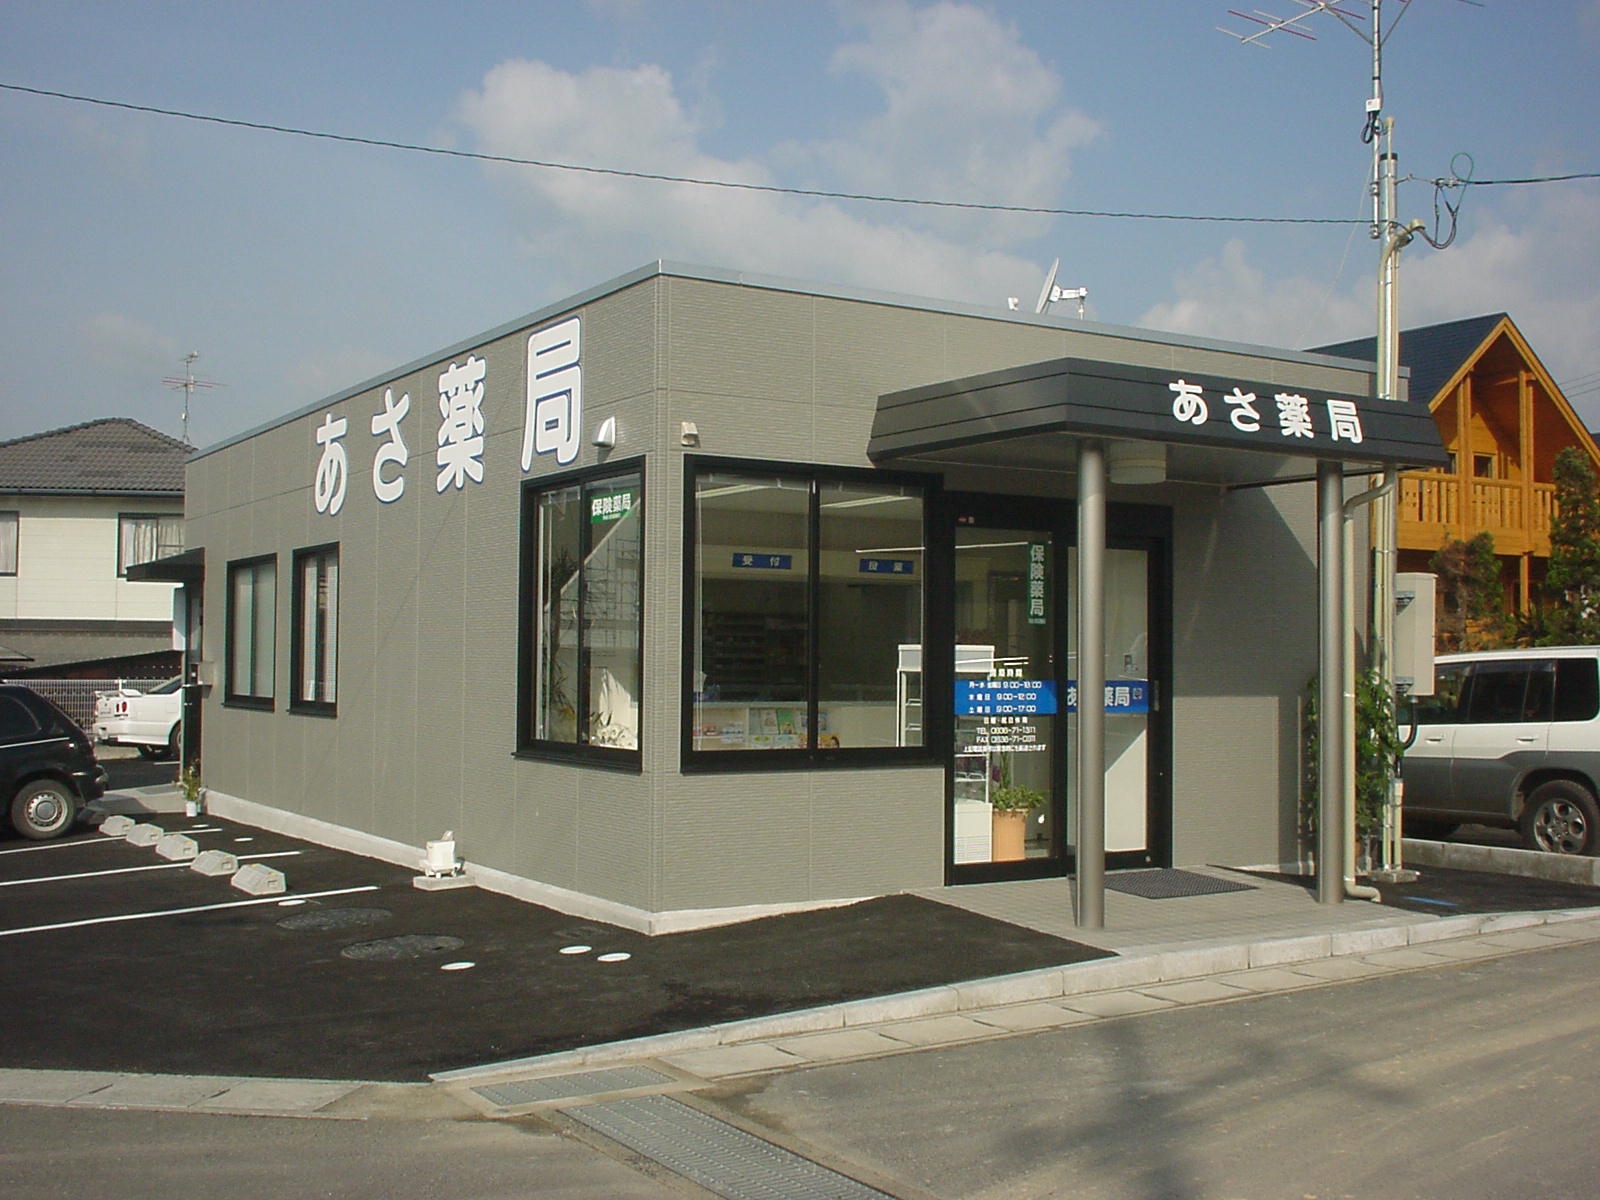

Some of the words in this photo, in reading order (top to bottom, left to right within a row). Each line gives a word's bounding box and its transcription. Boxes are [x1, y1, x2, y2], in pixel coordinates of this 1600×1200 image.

[314, 314, 582, 517] あさ薬局
[1168, 379, 1364, 444] あさ薬局
[592, 493, 631, 516] 保険薬局
[1030, 544, 1044, 616] 保険薬局
